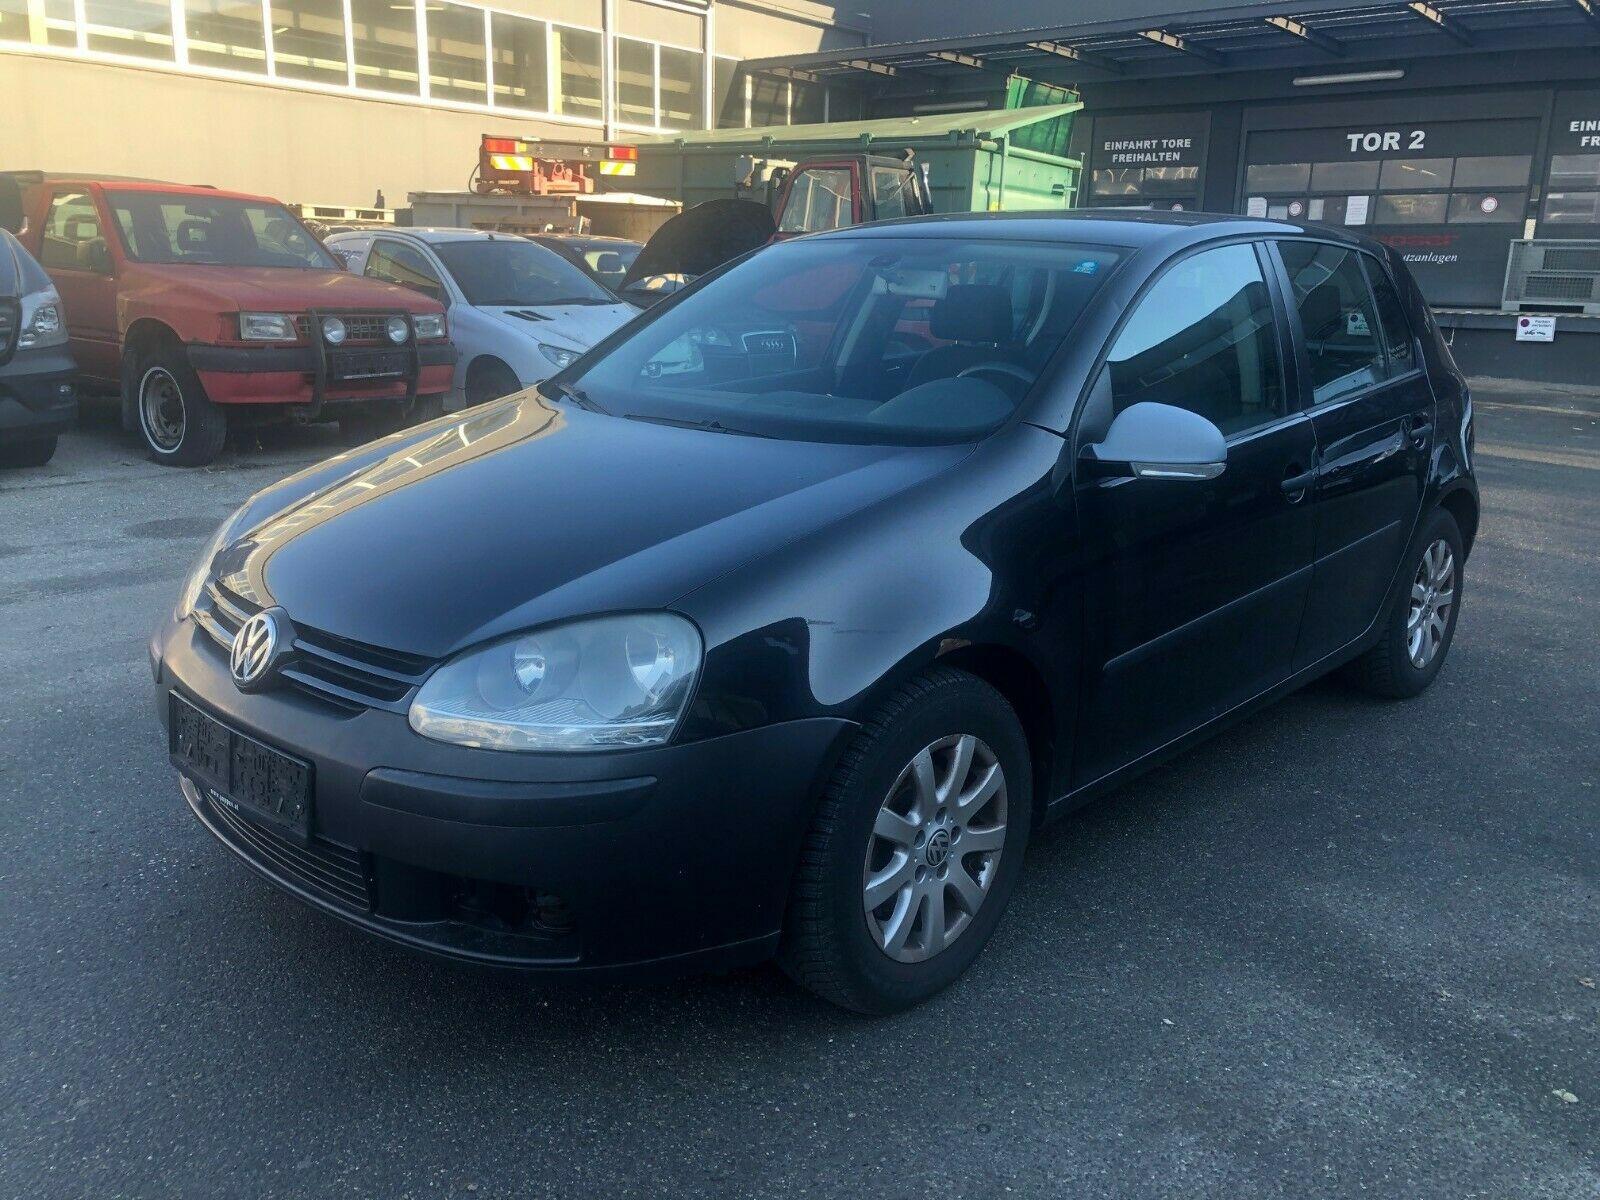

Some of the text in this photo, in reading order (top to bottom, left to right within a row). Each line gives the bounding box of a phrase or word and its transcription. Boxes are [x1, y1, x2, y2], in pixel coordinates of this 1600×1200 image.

[1570, 121, 1600, 131] EIN
[1104, 139, 1191, 151] EINFAHRT TORE
[1347, 131, 1425, 152] TOR 2
[1112, 152, 1180, 163] FREIHALTEN
